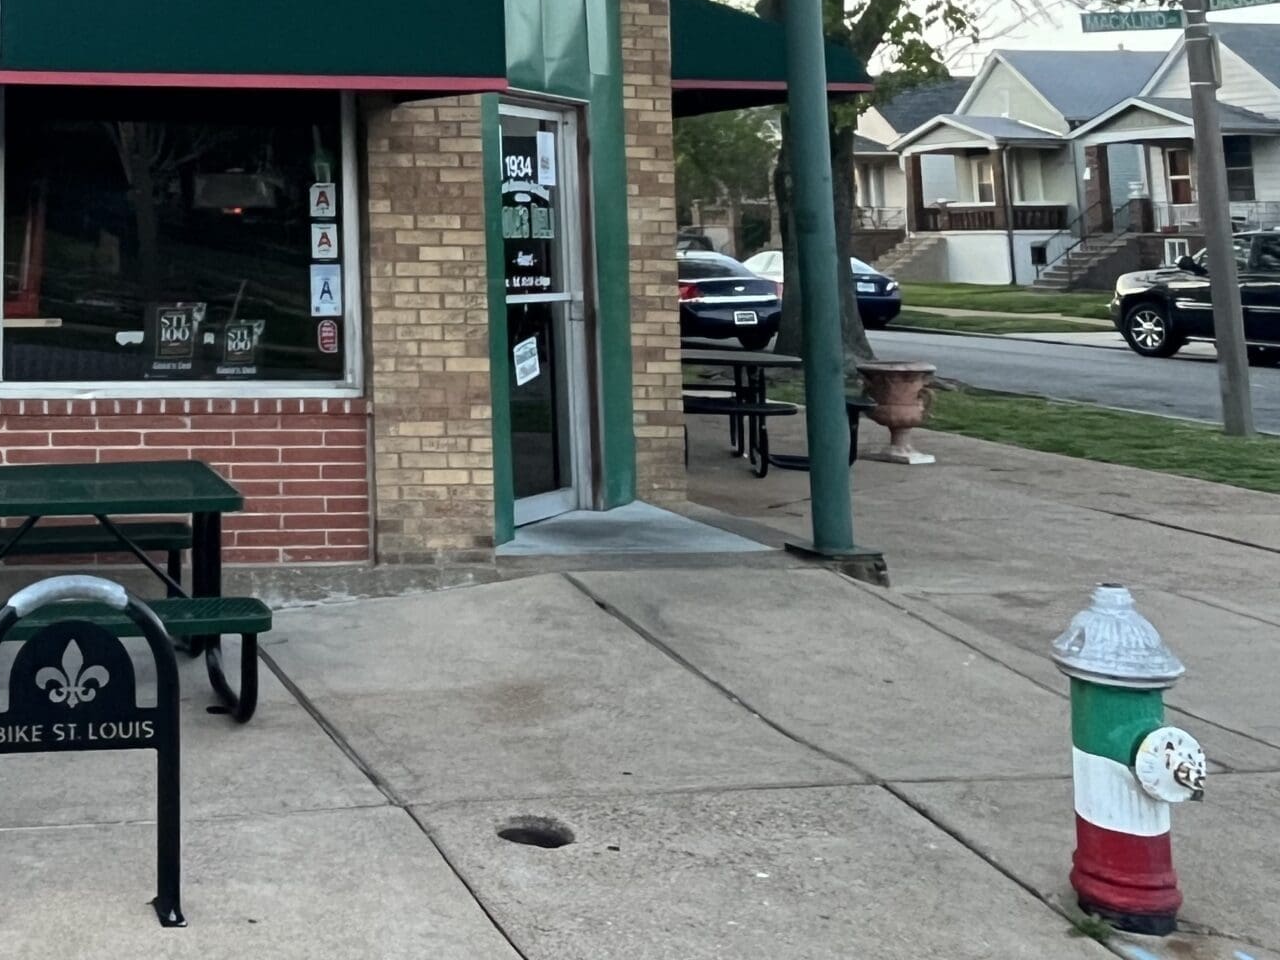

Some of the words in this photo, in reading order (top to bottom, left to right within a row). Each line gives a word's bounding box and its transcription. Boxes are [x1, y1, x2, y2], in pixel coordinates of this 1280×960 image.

[1085, 12, 1166, 30] MACKLIND
[504, 155, 532, 177] 1934
[315, 191, 331, 207] A
[317, 231, 332, 248] A
[319, 280, 334, 301] A
[161, 327, 190, 341] 100
[227, 339, 252, 352] 100
[52, 723, 81, 741] ST.
[88, 720, 155, 740] LOUIS
